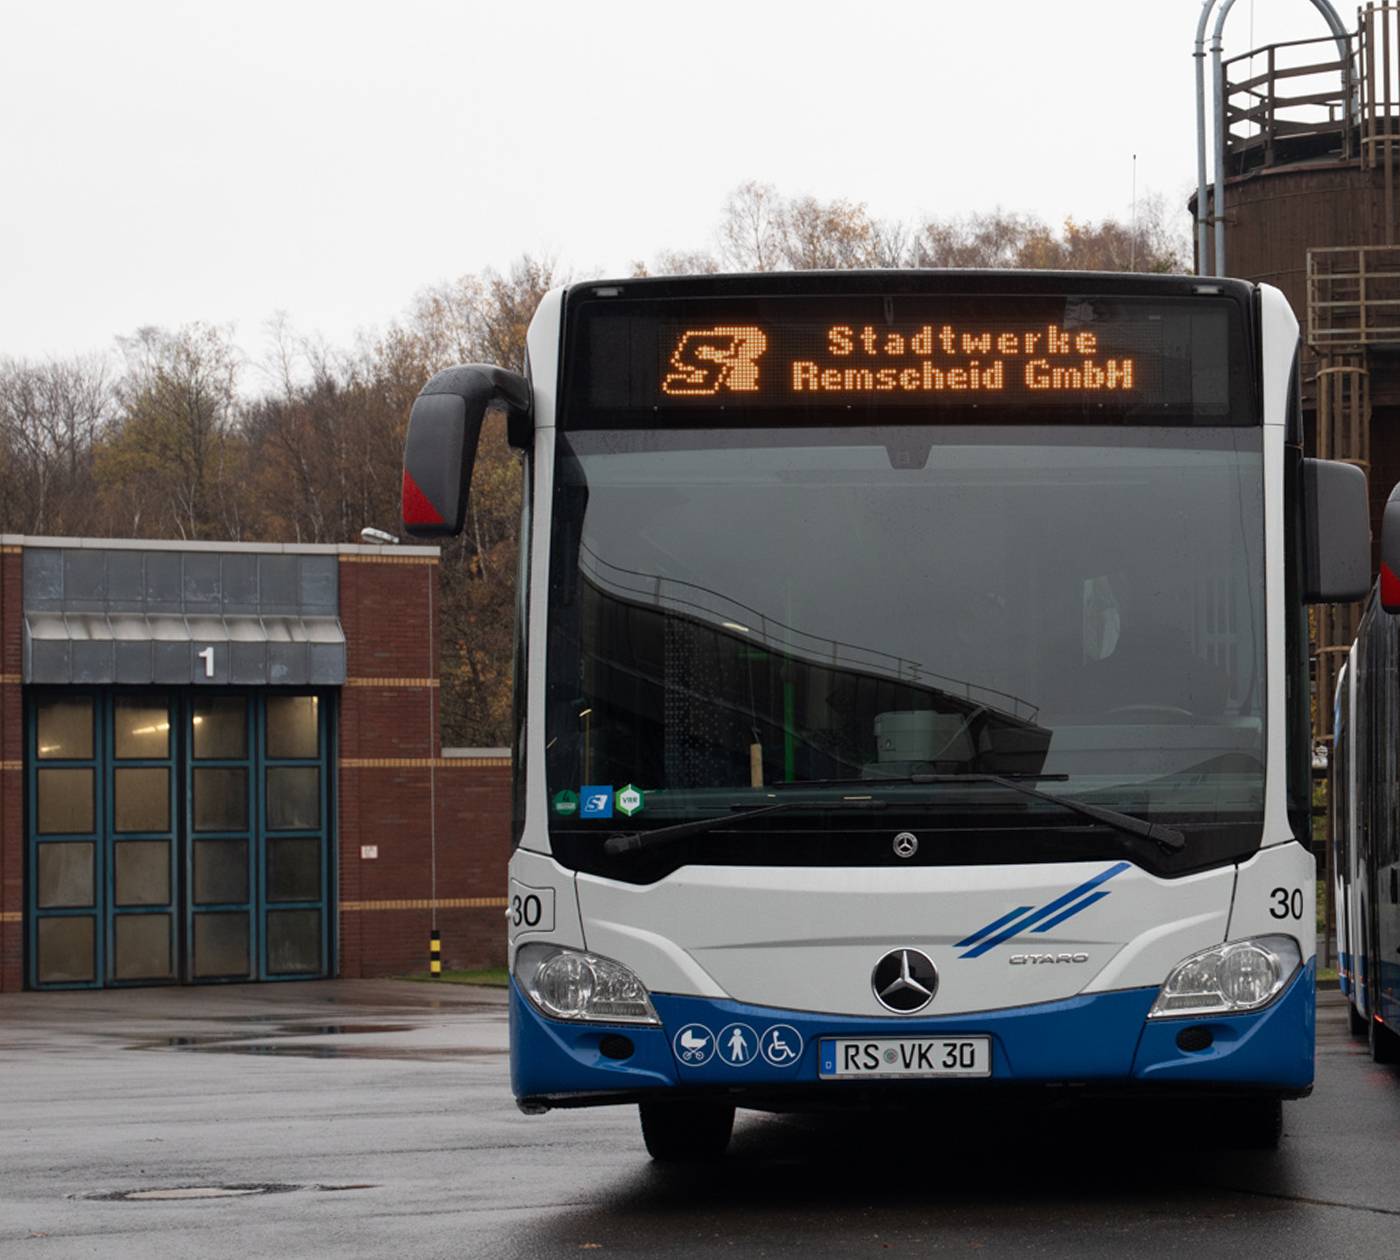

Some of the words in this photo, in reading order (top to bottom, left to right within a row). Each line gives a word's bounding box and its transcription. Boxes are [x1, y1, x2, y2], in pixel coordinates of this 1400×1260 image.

[828, 326, 1097, 355] Stadtwerke
[793, 360, 1003, 390] Remscheid
[1025, 359, 1133, 390] GmbH
[199, 646, 215, 677] 1
[513, 894, 542, 927] 30
[1269, 887, 1303, 920] 30
[1009, 952, 1089, 965] CITARO
[844, 1043, 880, 1070] RS
[900, 1043, 935, 1069] VK
[942, 1043, 975, 1068] 30
